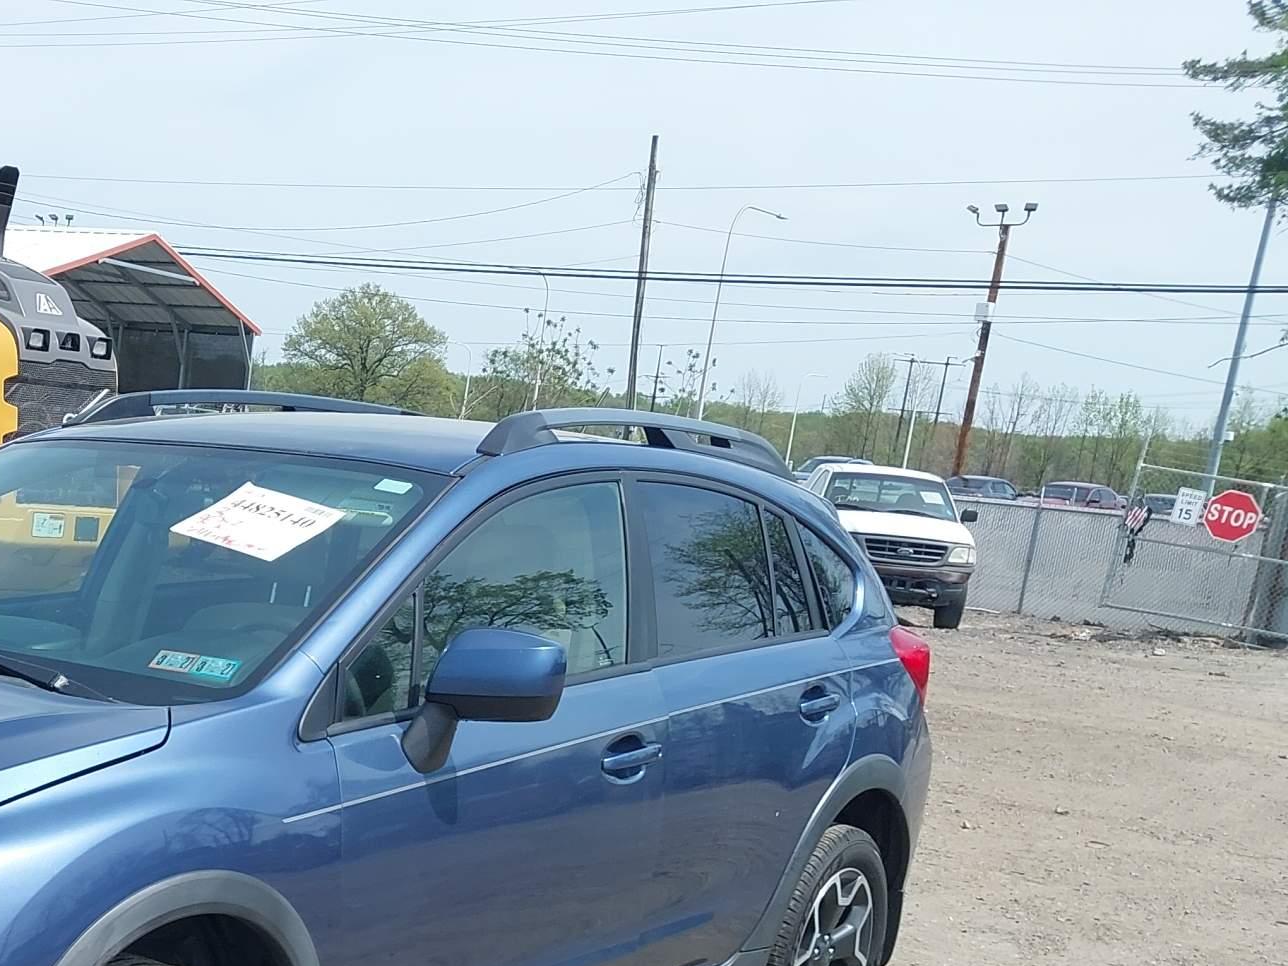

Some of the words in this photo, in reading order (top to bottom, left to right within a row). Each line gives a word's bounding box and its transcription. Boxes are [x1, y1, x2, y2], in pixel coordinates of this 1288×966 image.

[1181, 491, 1203, 501] SPEED
[1180, 499, 1198, 507] LIMIT
[230, 499, 317, 528] 44825140
[1178, 508, 1192, 520] 15
[1207, 503, 1257, 529] STOP
